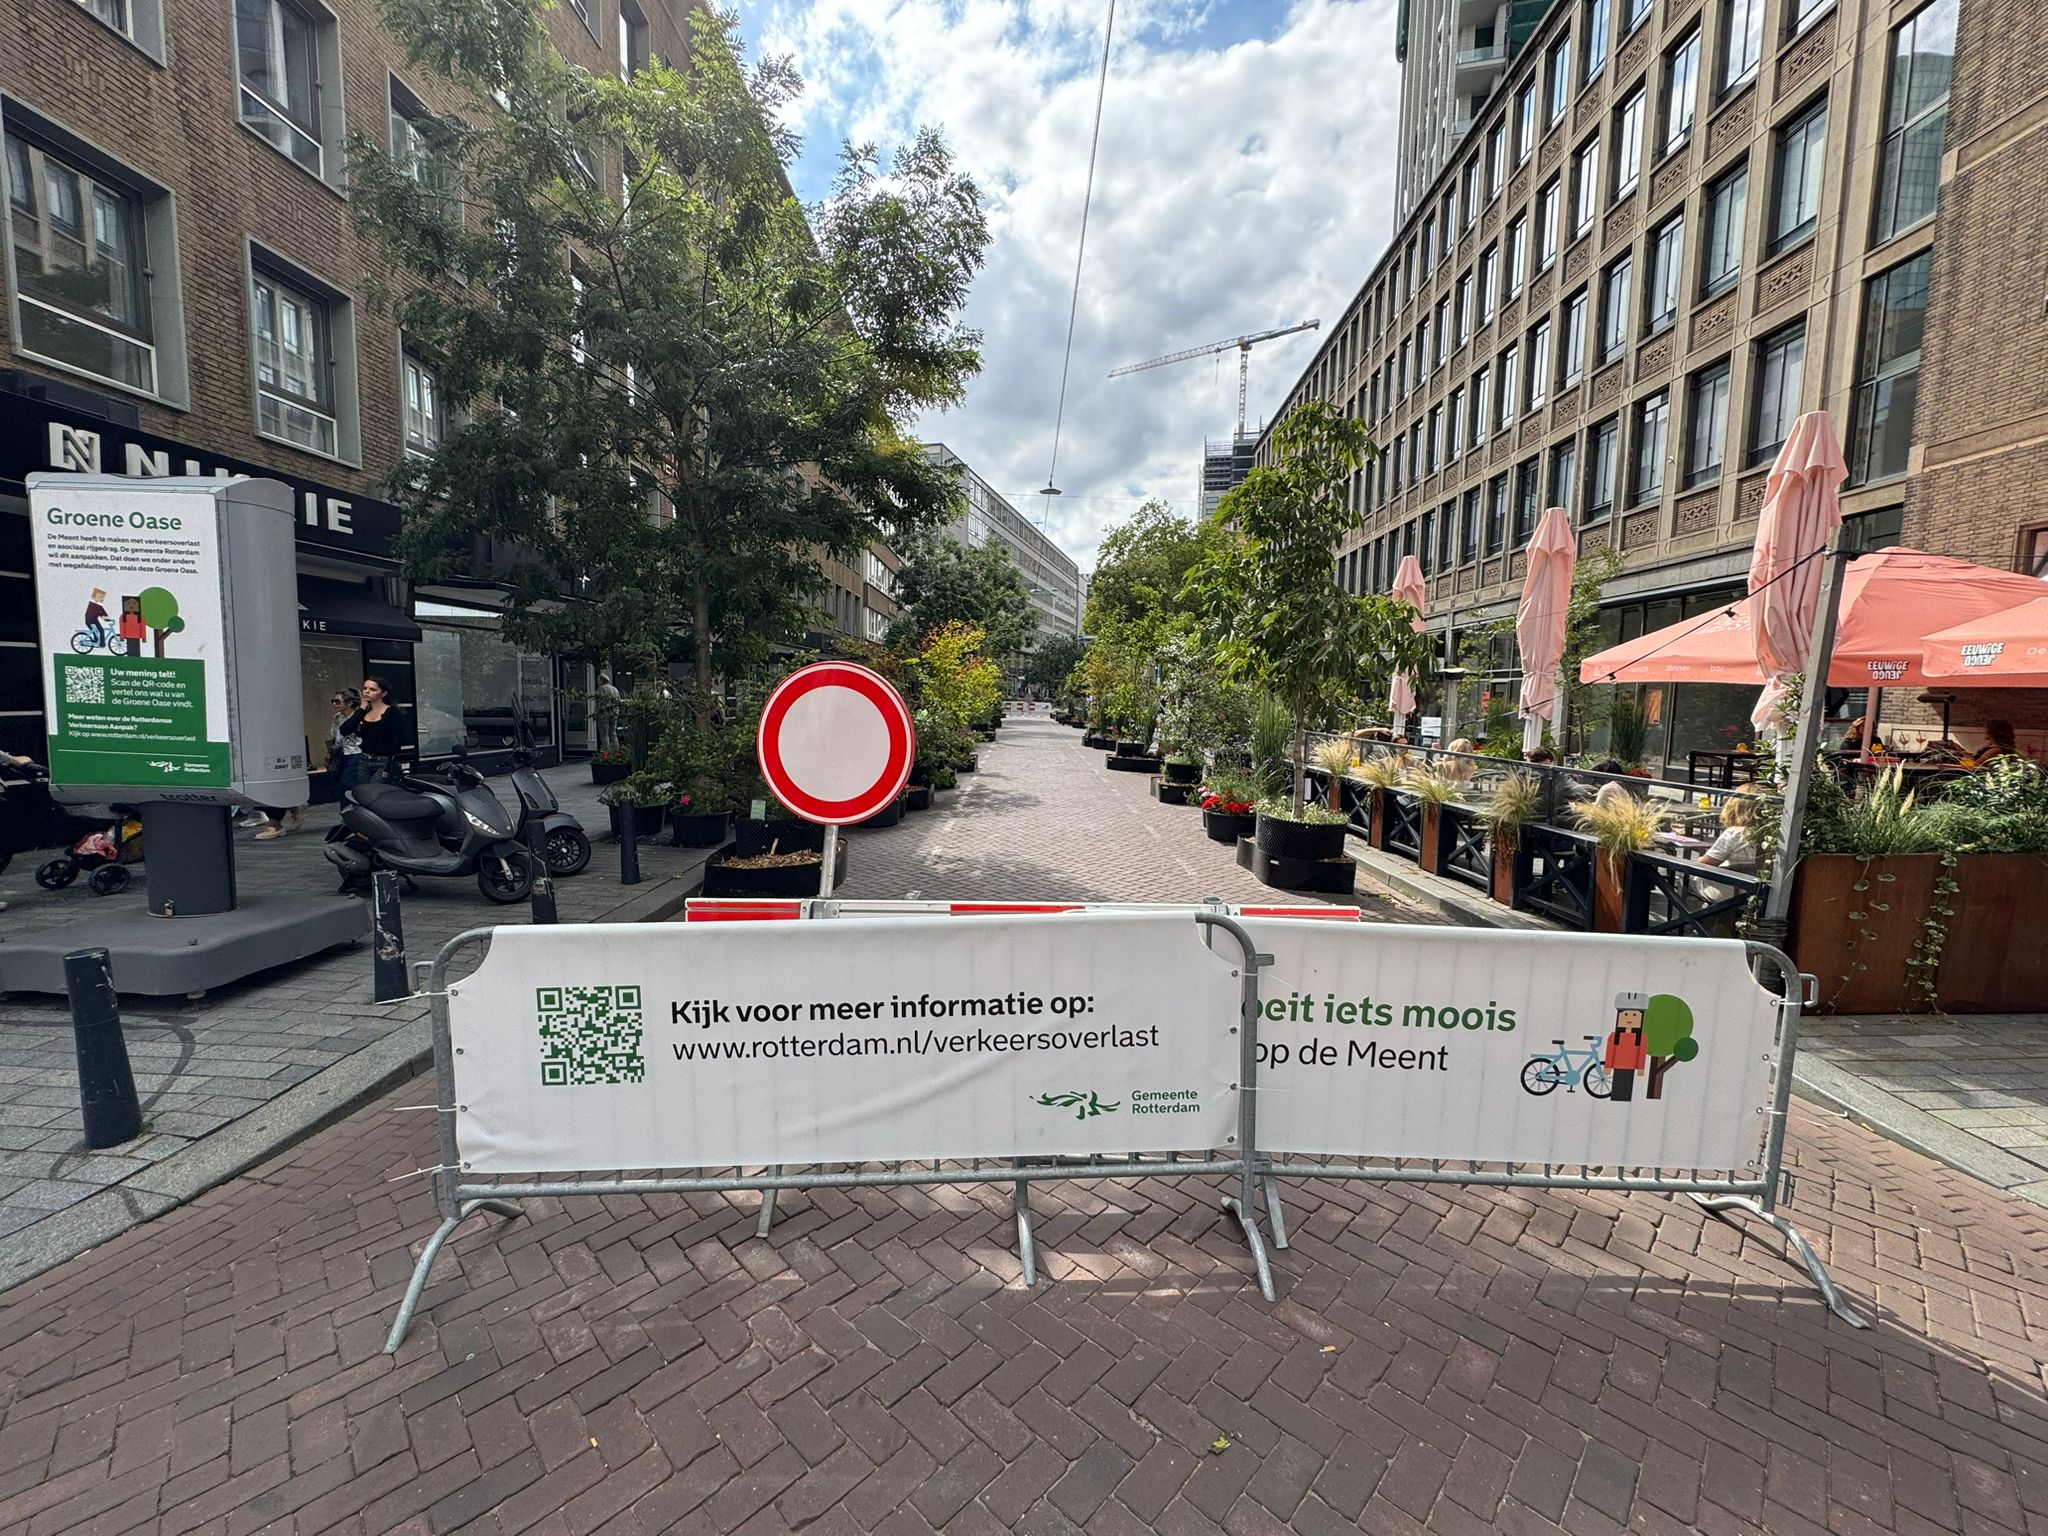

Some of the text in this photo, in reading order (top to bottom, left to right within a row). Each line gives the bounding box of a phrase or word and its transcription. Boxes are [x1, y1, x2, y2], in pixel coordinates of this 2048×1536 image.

[47, 508, 182, 530] Groene Oase
[126, 670, 157, 678] mening
[159, 670, 176, 678] telt!
[671, 992, 1094, 1027] Kijk voor meer informatie op:
[1324, 994, 1392, 1026] iets
[1402, 1001, 1516, 1032] moois
[672, 1024, 1160, 1060] www.rotterdam.nl/verkeersoverlast
[1299, 1038, 1338, 1066] de
[1348, 1040, 1448, 1072] Meent
[1132, 1090, 1198, 1102] Gemeente
[1132, 1102, 1200, 1114] Rotterdam
